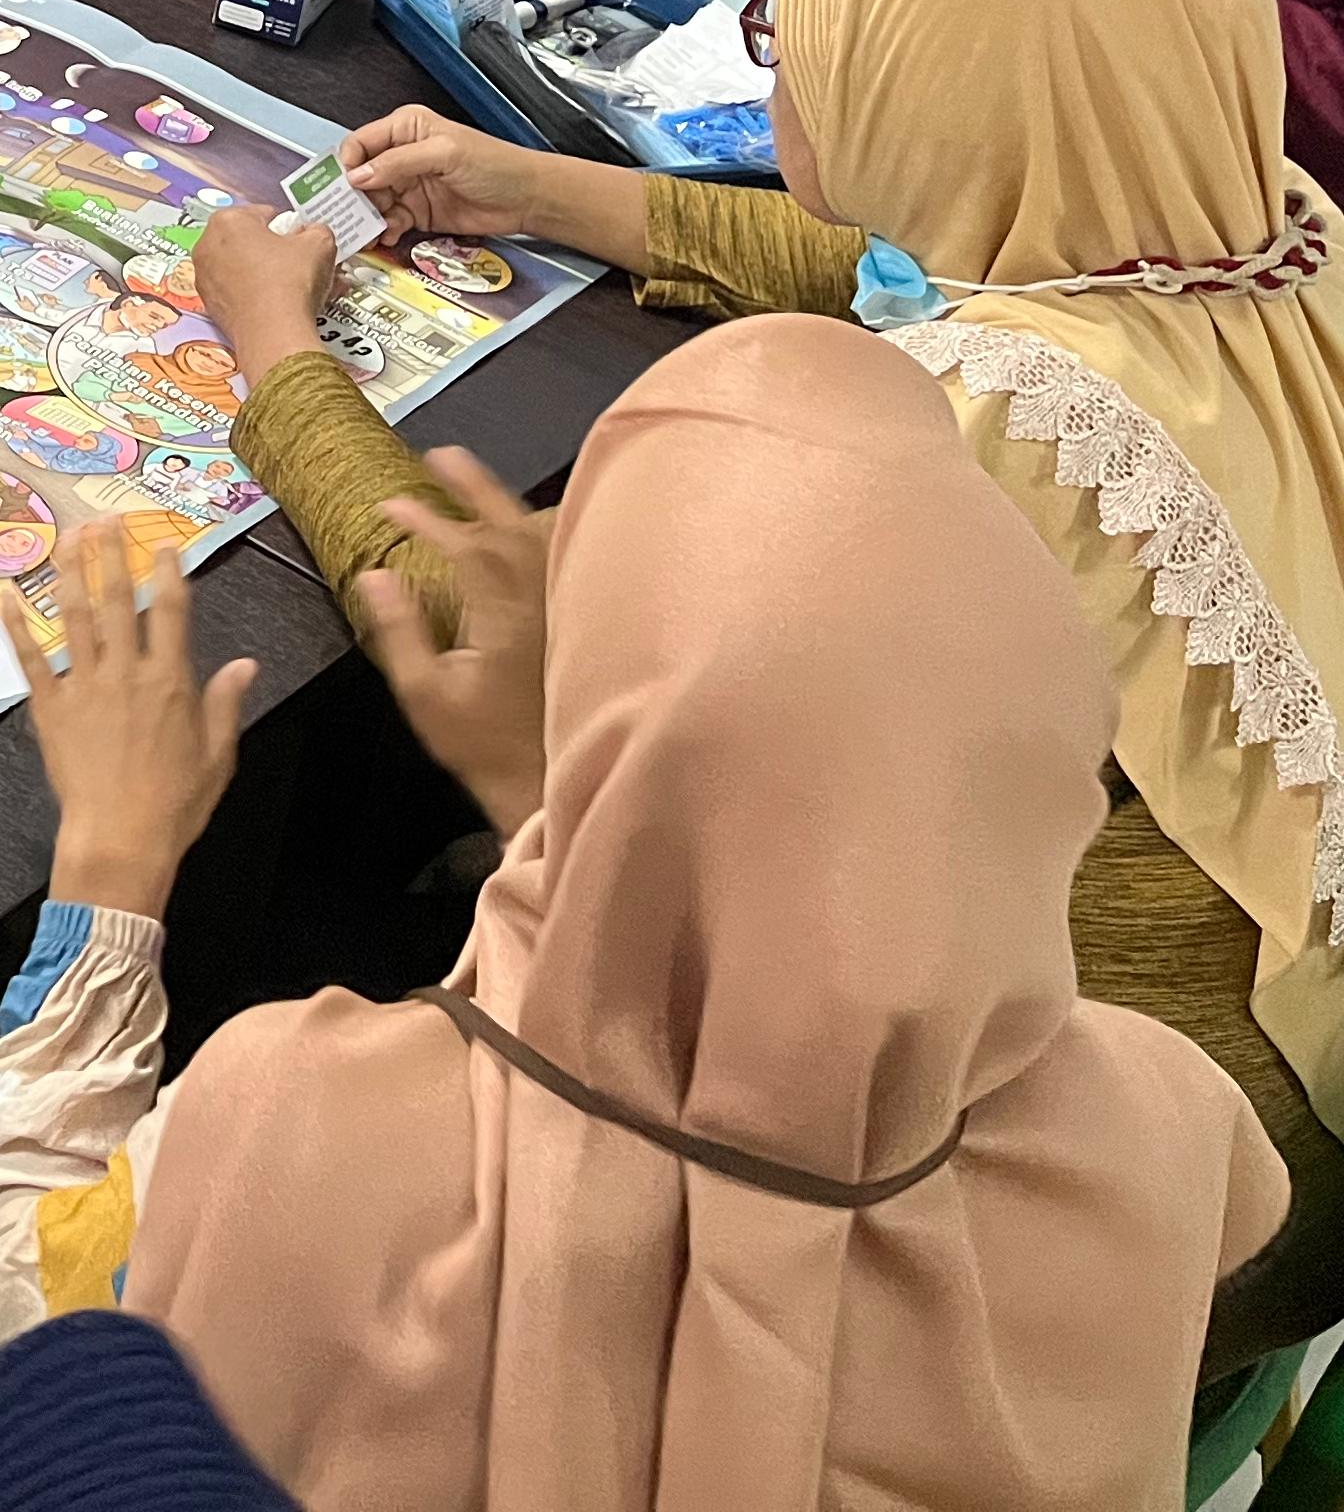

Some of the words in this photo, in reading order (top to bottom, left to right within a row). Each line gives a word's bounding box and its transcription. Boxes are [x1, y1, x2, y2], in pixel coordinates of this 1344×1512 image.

[81, 199, 141, 236] Buatlah
[141, 229, 188, 257] Suatu
[64, 332, 152, 384] Penilaian
[358, 323, 399, 350] Anda
[119, 378, 214, 433] Ramadan
